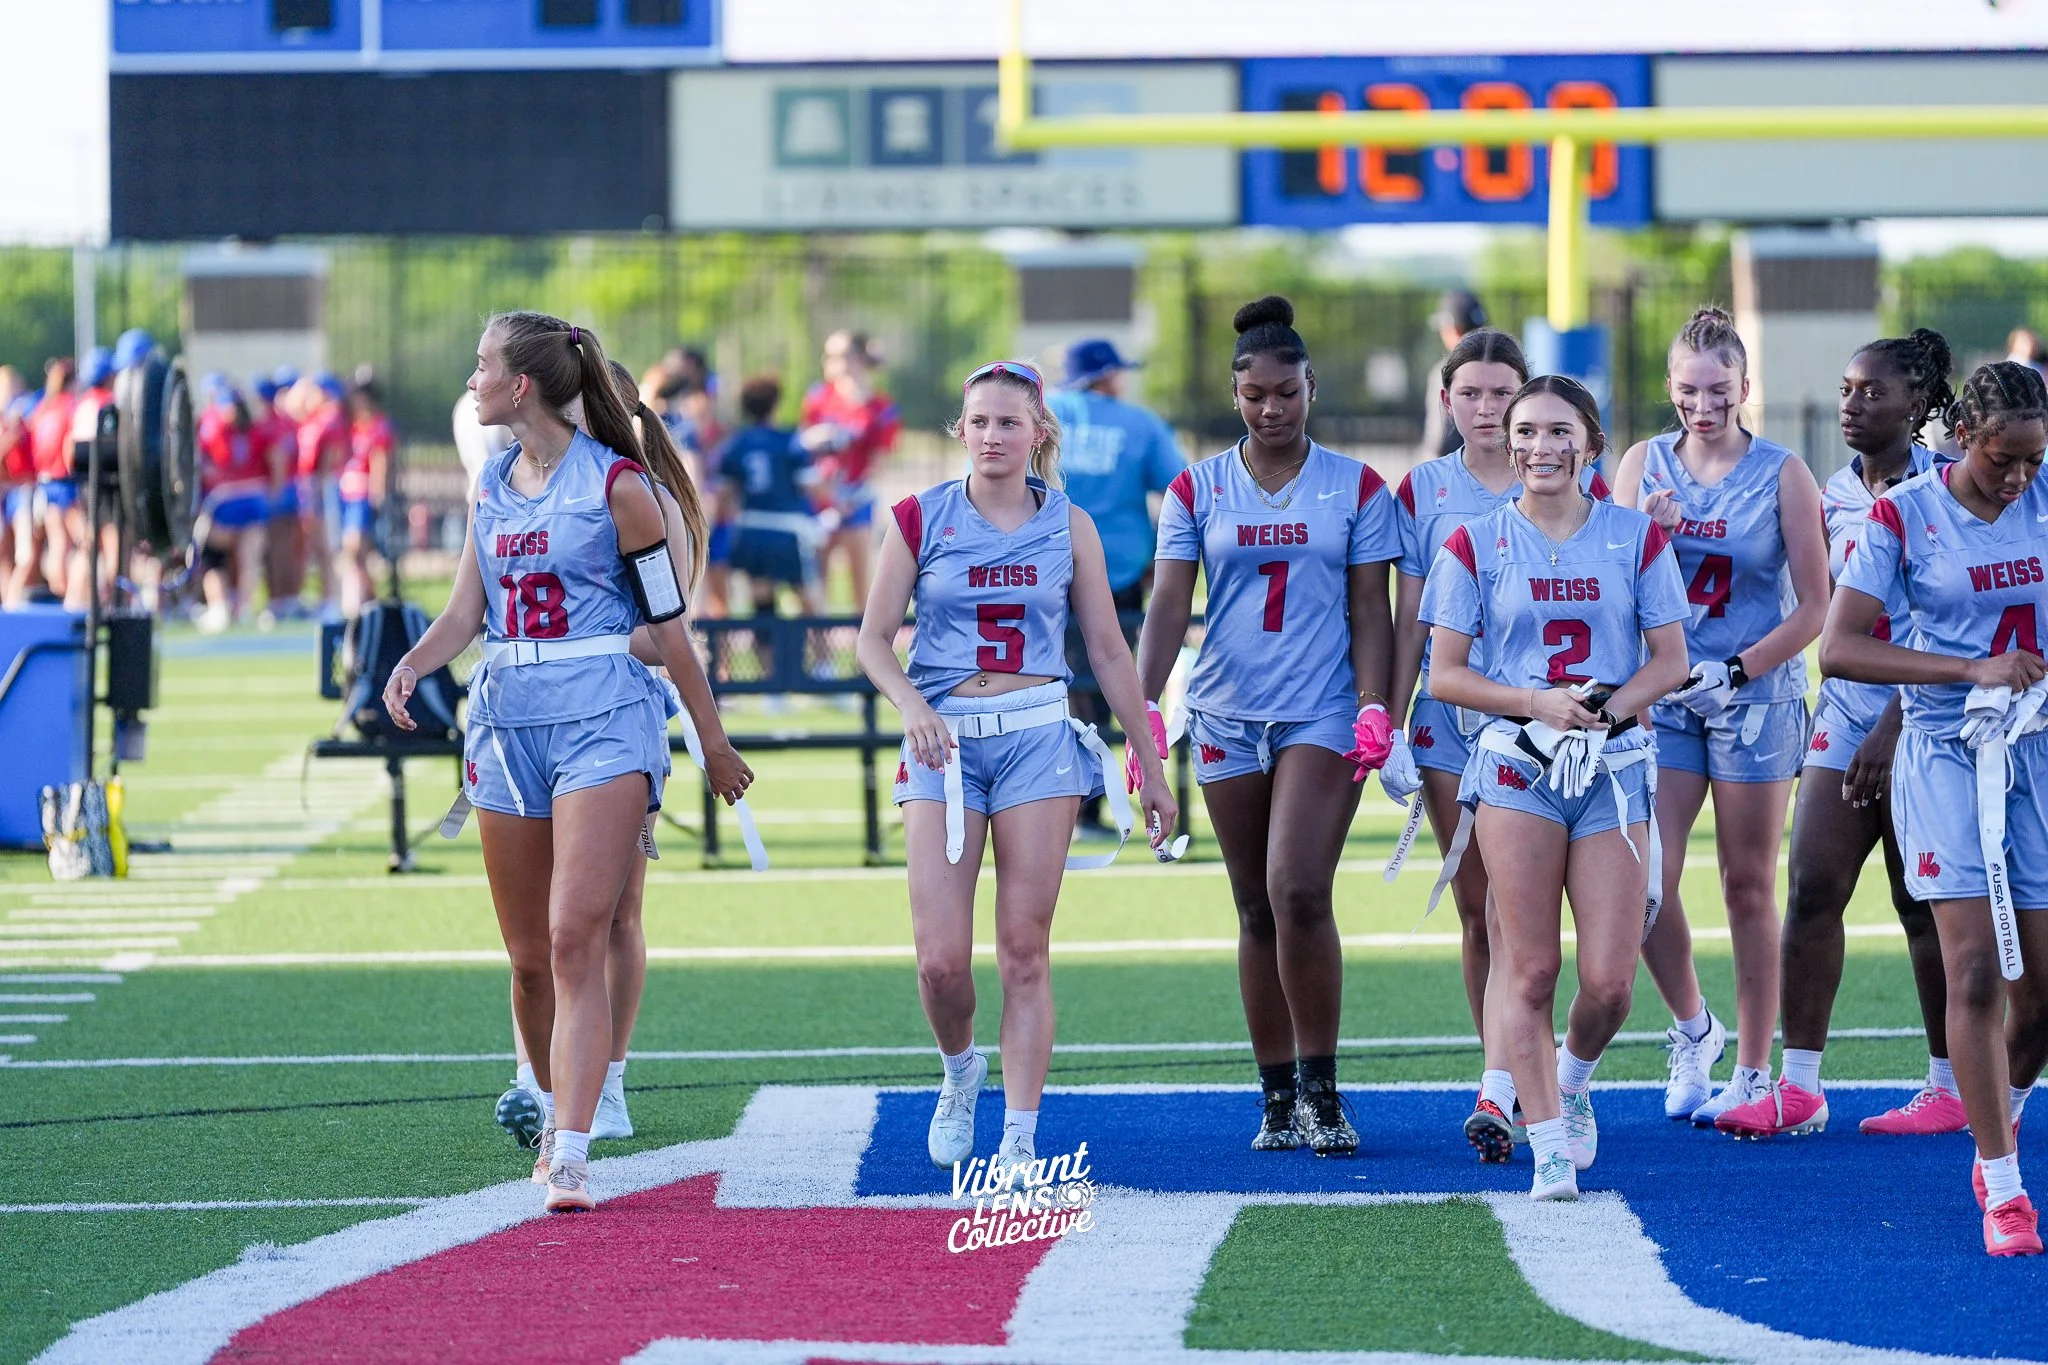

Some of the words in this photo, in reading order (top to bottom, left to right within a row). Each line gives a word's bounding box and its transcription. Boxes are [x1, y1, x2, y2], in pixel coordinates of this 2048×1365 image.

[1316, 82, 1619, 202] 12:00
[495, 530, 549, 558] WEISS
[1237, 523, 1309, 546] WEISS
[968, 565, 1038, 588] WEISS
[1258, 561, 1290, 632] 1
[1529, 577, 1601, 601] WEISS
[1967, 556, 2045, 592] WEISS
[499, 572, 569, 639] 18
[976, 604, 1026, 673] 5
[1543, 619, 1594, 685] 2
[1388, 820, 1418, 872] FOOTBALL
[1992, 873, 2005, 905] USA
[1997, 905, 2017, 971] FOOTBALL
